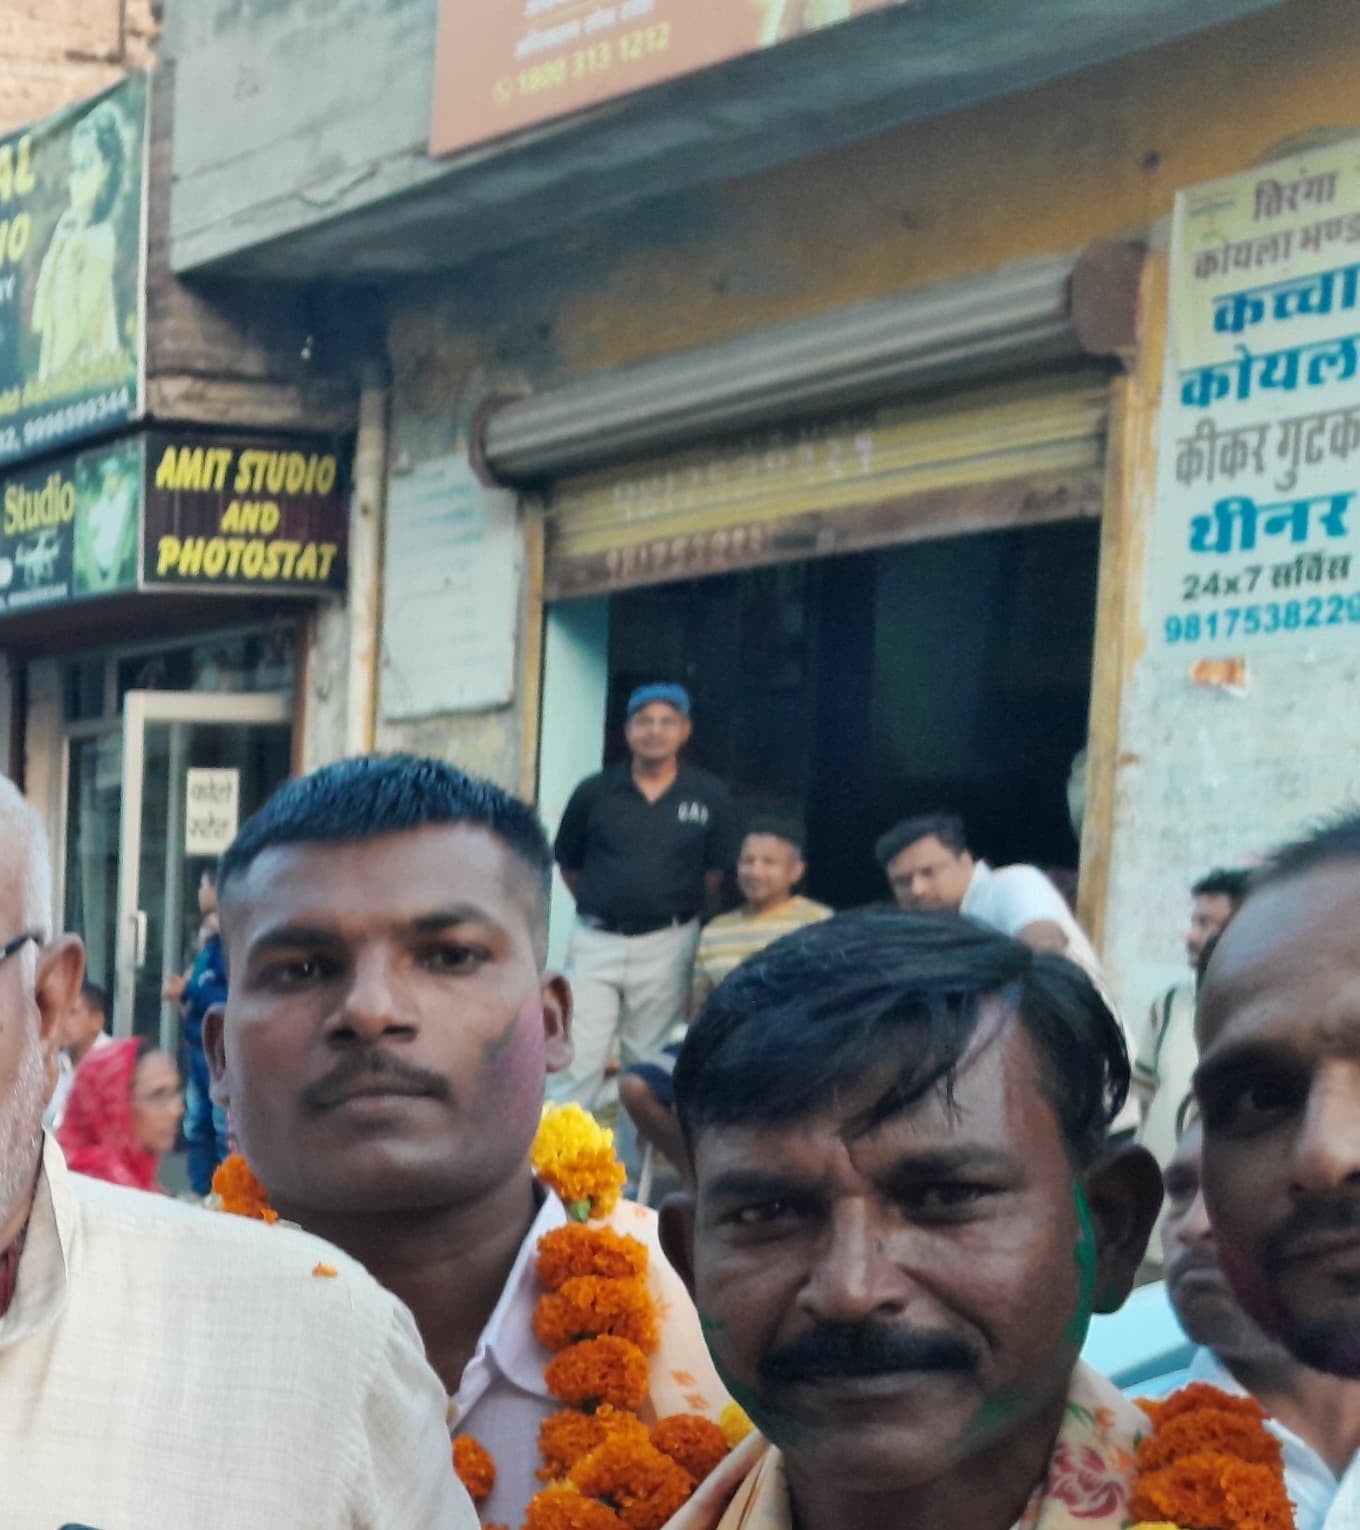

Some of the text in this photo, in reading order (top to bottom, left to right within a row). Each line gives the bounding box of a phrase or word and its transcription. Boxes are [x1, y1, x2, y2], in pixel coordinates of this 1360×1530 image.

[1253, 167, 1338, 221] तिरंगा
[1194, 229, 1296, 279] कोयला
[1213, 262, 1360, 333] कच्चा
[155, 446, 336, 495] AMIT STUDIO
[1176, 418, 1270, 486] कीकर
[4, 472, 76, 535] Studio
[221, 501, 280, 534] AND
[1189, 490, 1356, 555] थीनर
[156, 535, 337, 580] PHOTOSTAT
[1183, 549, 1351, 600] 24x7 सर्विस
